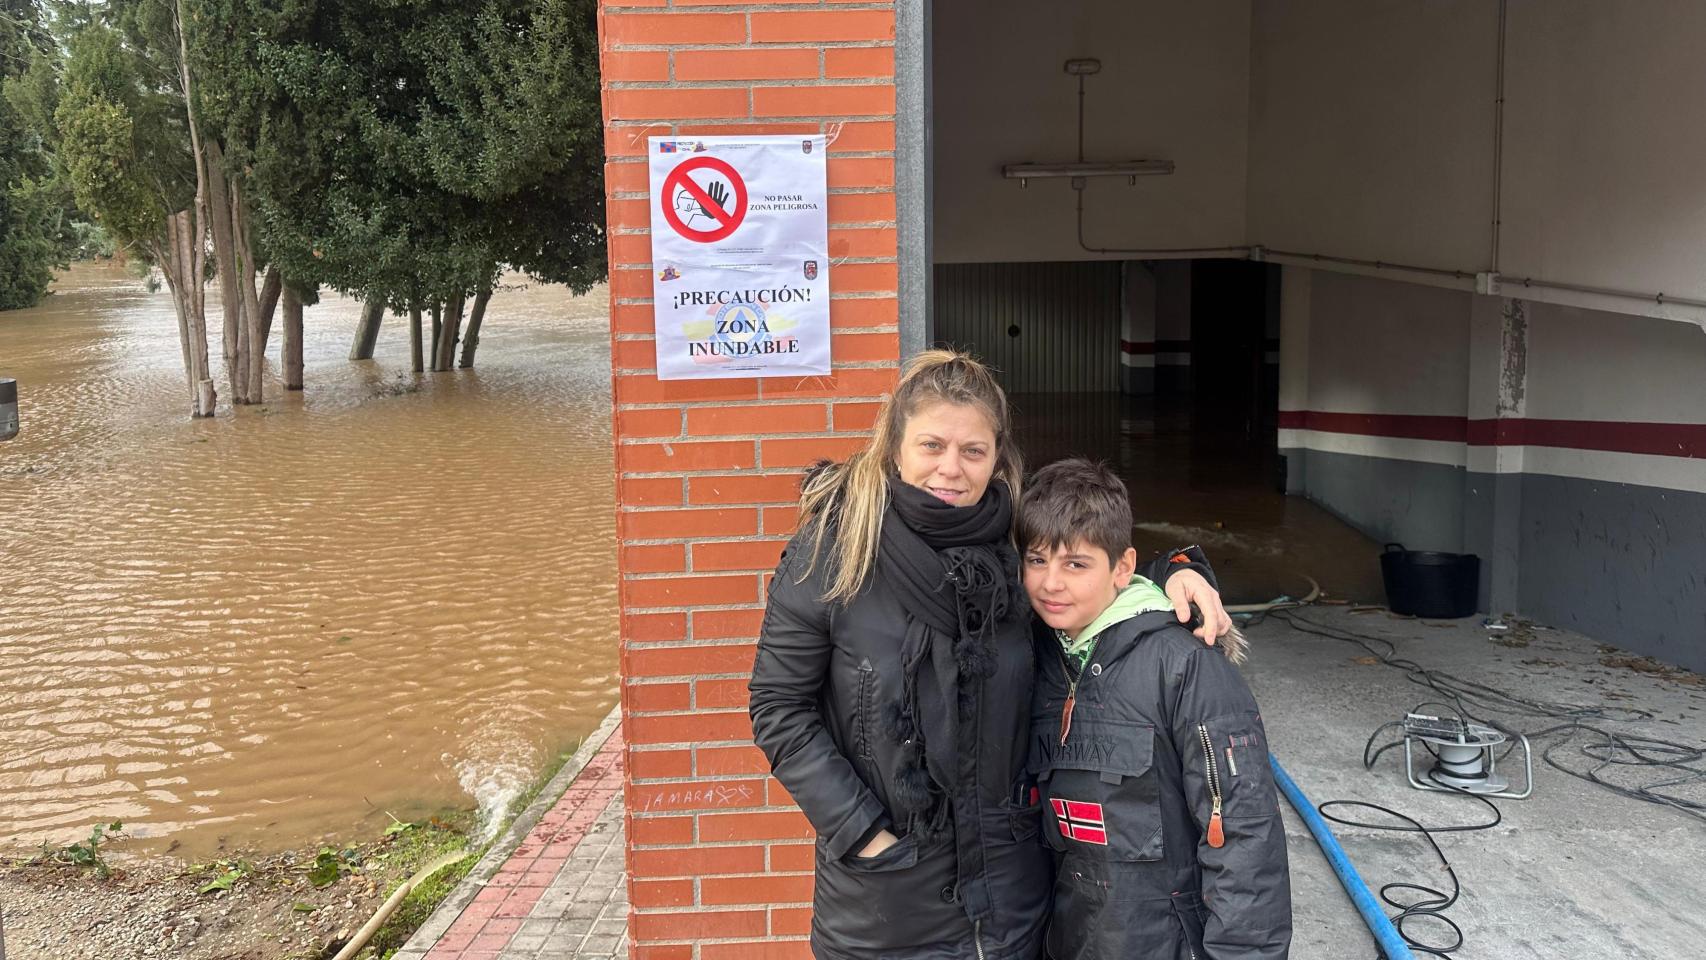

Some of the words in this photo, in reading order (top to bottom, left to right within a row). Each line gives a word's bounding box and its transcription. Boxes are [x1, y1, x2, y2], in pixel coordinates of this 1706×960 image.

[777, 194, 803, 202] PASAR
[750, 203, 772, 211] ZONA
[773, 202, 818, 210] PELIGROSA
[673, 285, 811, 309] ¡PRECAUCIÓN!
[717, 319, 770, 334] ZONA
[688, 339, 800, 356] INUNDABLE
[1038, 734, 1116, 764] NORWAY
